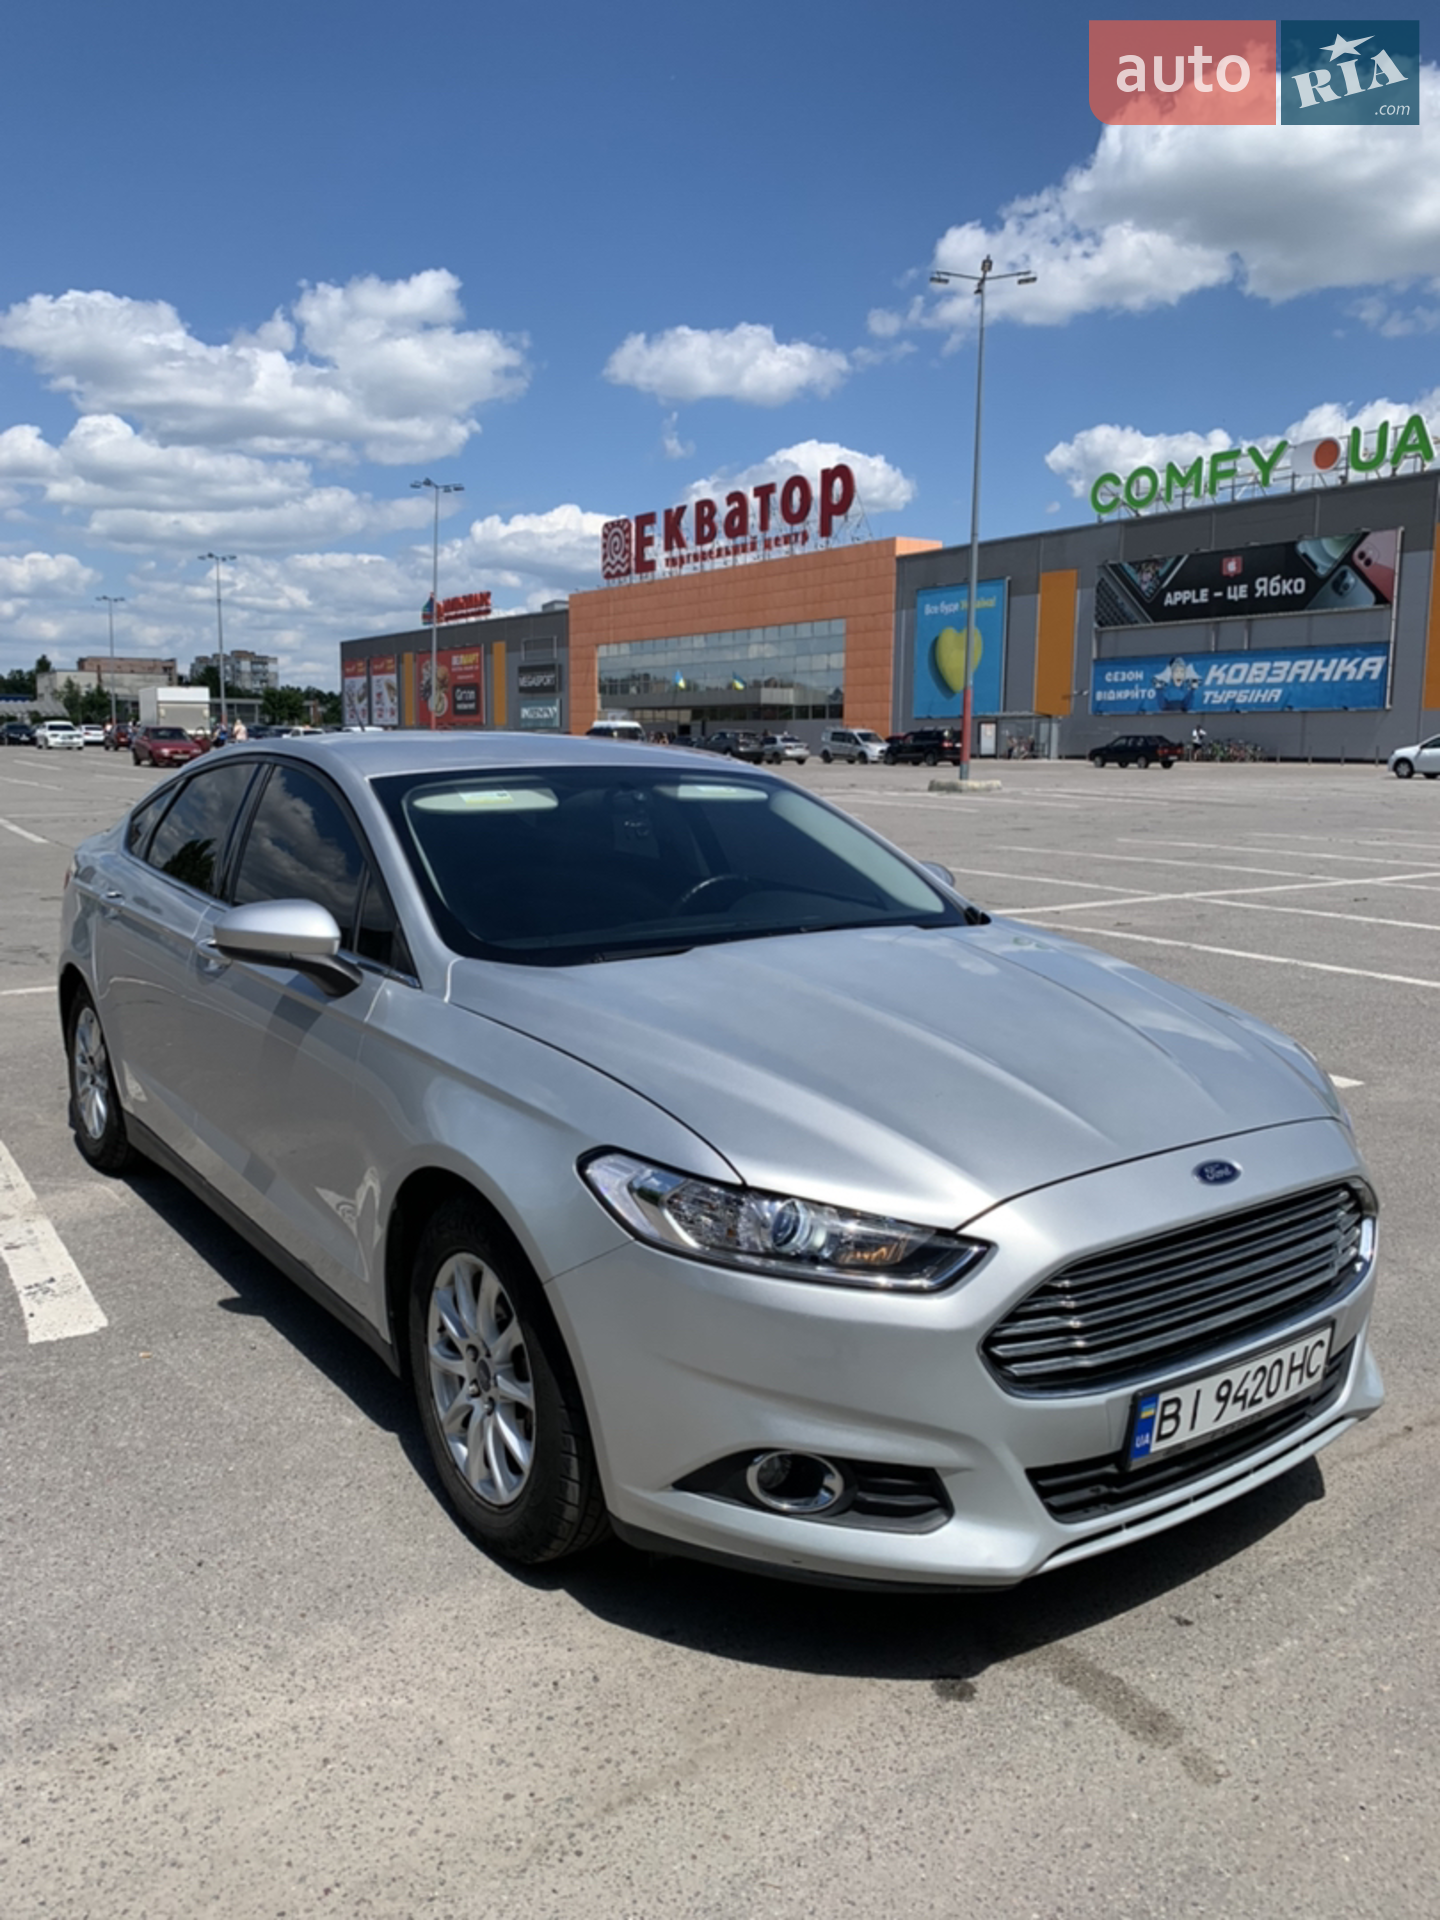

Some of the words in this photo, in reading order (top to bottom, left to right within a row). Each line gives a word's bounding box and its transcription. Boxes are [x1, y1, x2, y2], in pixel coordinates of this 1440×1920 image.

[1090, 439, 1289, 515] COMFY
[1349, 413, 1435, 473] UA
[1164, 588, 1209, 607] APPLE
[1226, 584, 1249, 601] ЦЕ
[1104, 669, 1145, 683] СЕЗОН
[1204, 655, 1388, 686] КОВЗАНКА
[1202, 688, 1283, 705] ТУРБІНА
[1203, 1163, 1233, 1181] Ford
[1155, 1388, 1202, 1443] BI
[1212, 1357, 1285, 1424] 9420
[1284, 1338, 1326, 1392] HC
[1135, 1432, 1151, 1449] UA
